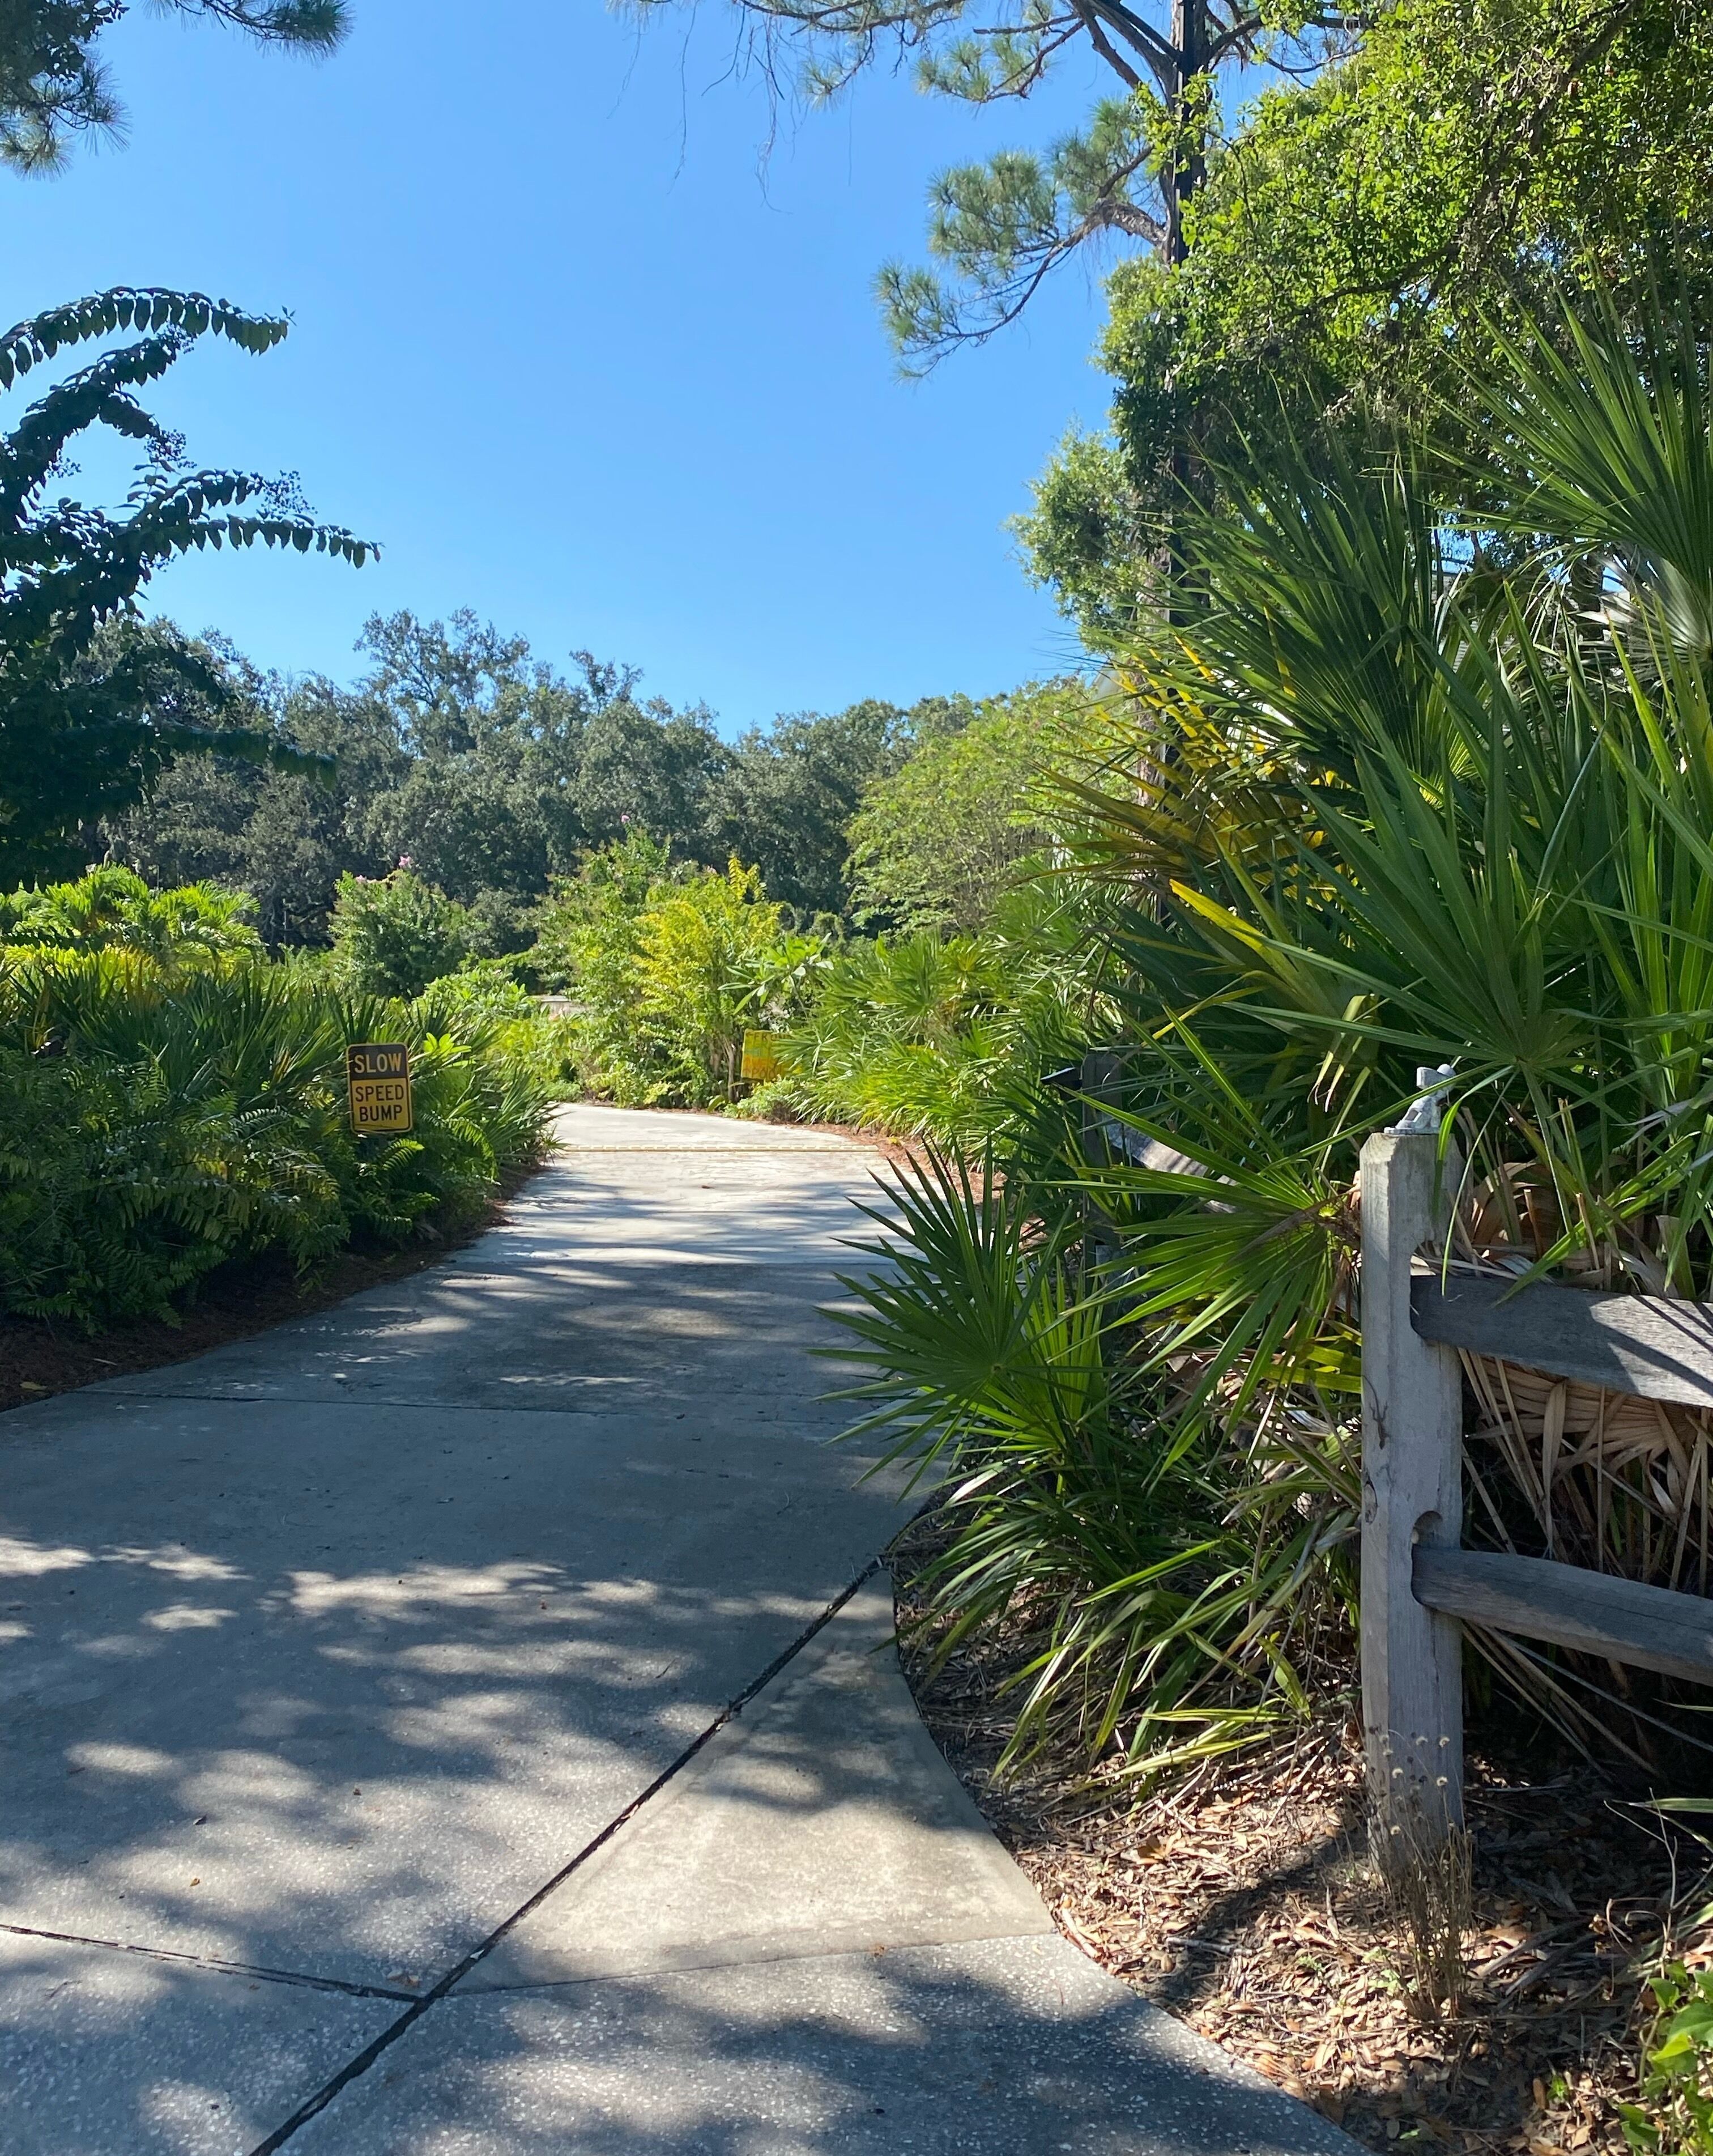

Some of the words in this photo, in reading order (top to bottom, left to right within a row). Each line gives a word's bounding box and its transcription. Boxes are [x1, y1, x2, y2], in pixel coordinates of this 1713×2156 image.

[354, 1053, 402, 1073] SLOW
[355, 1085, 404, 1102] SPEED
[359, 1105, 402, 1122] BUMP
